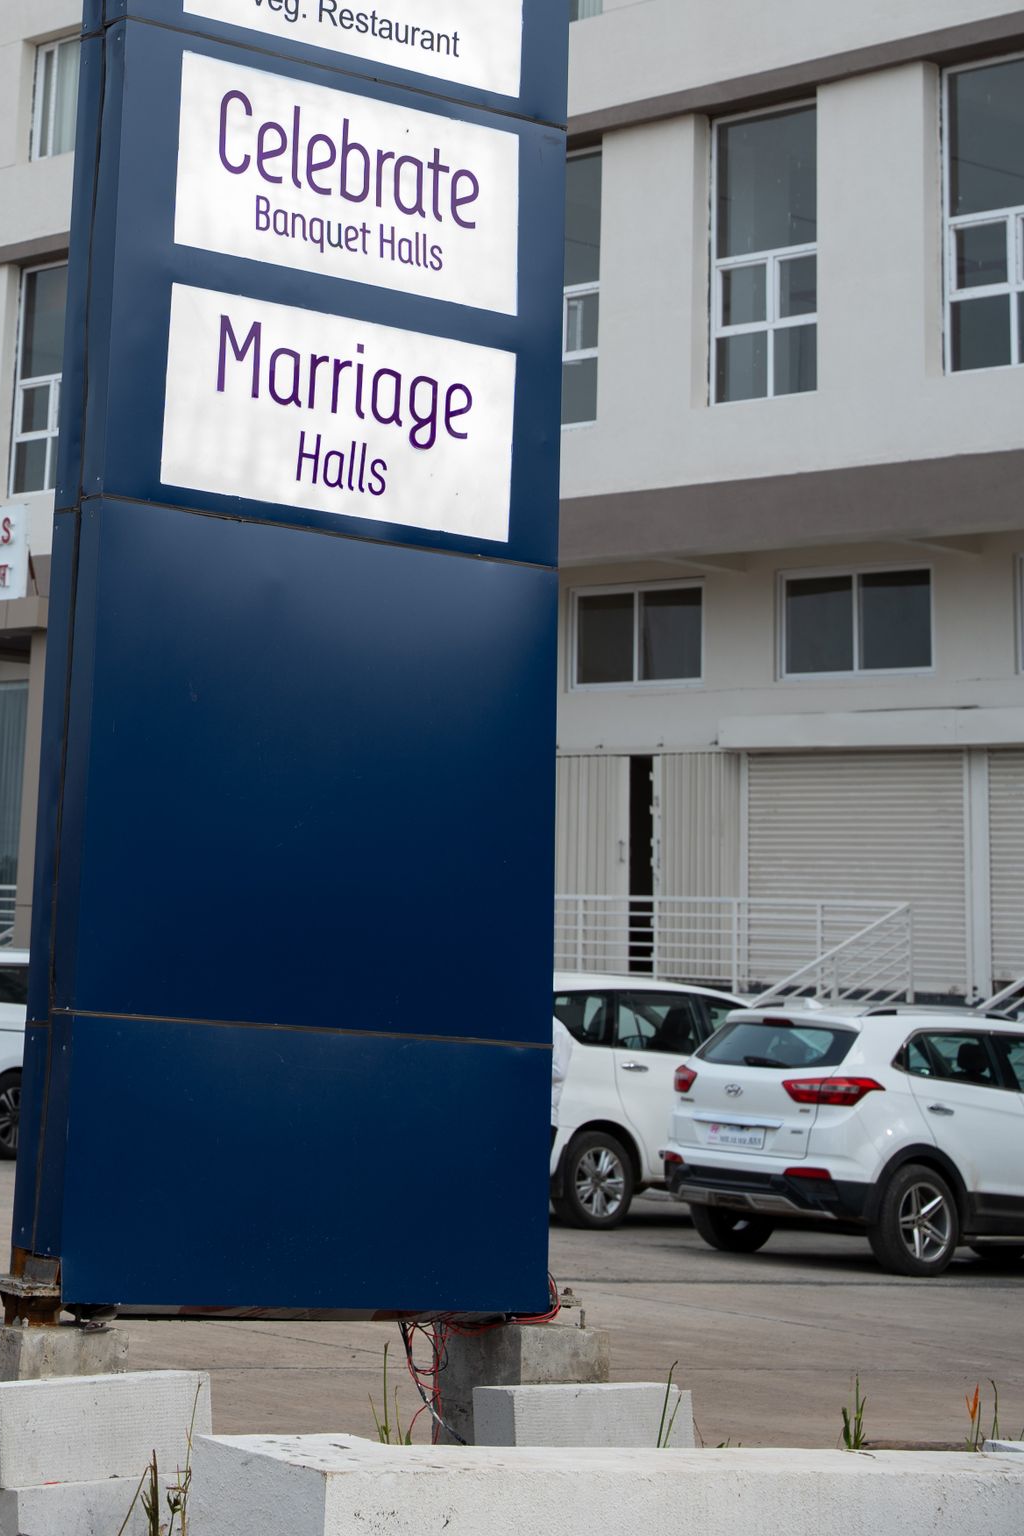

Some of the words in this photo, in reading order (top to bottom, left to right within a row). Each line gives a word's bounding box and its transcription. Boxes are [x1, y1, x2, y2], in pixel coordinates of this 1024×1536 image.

[218, 89, 480, 230] Celebrate
[255, 195, 371, 254] Banquet
[379, 224, 444, 271] Halls
[216, 314, 473, 450] Marriage
[296, 430, 388, 496] Halls
